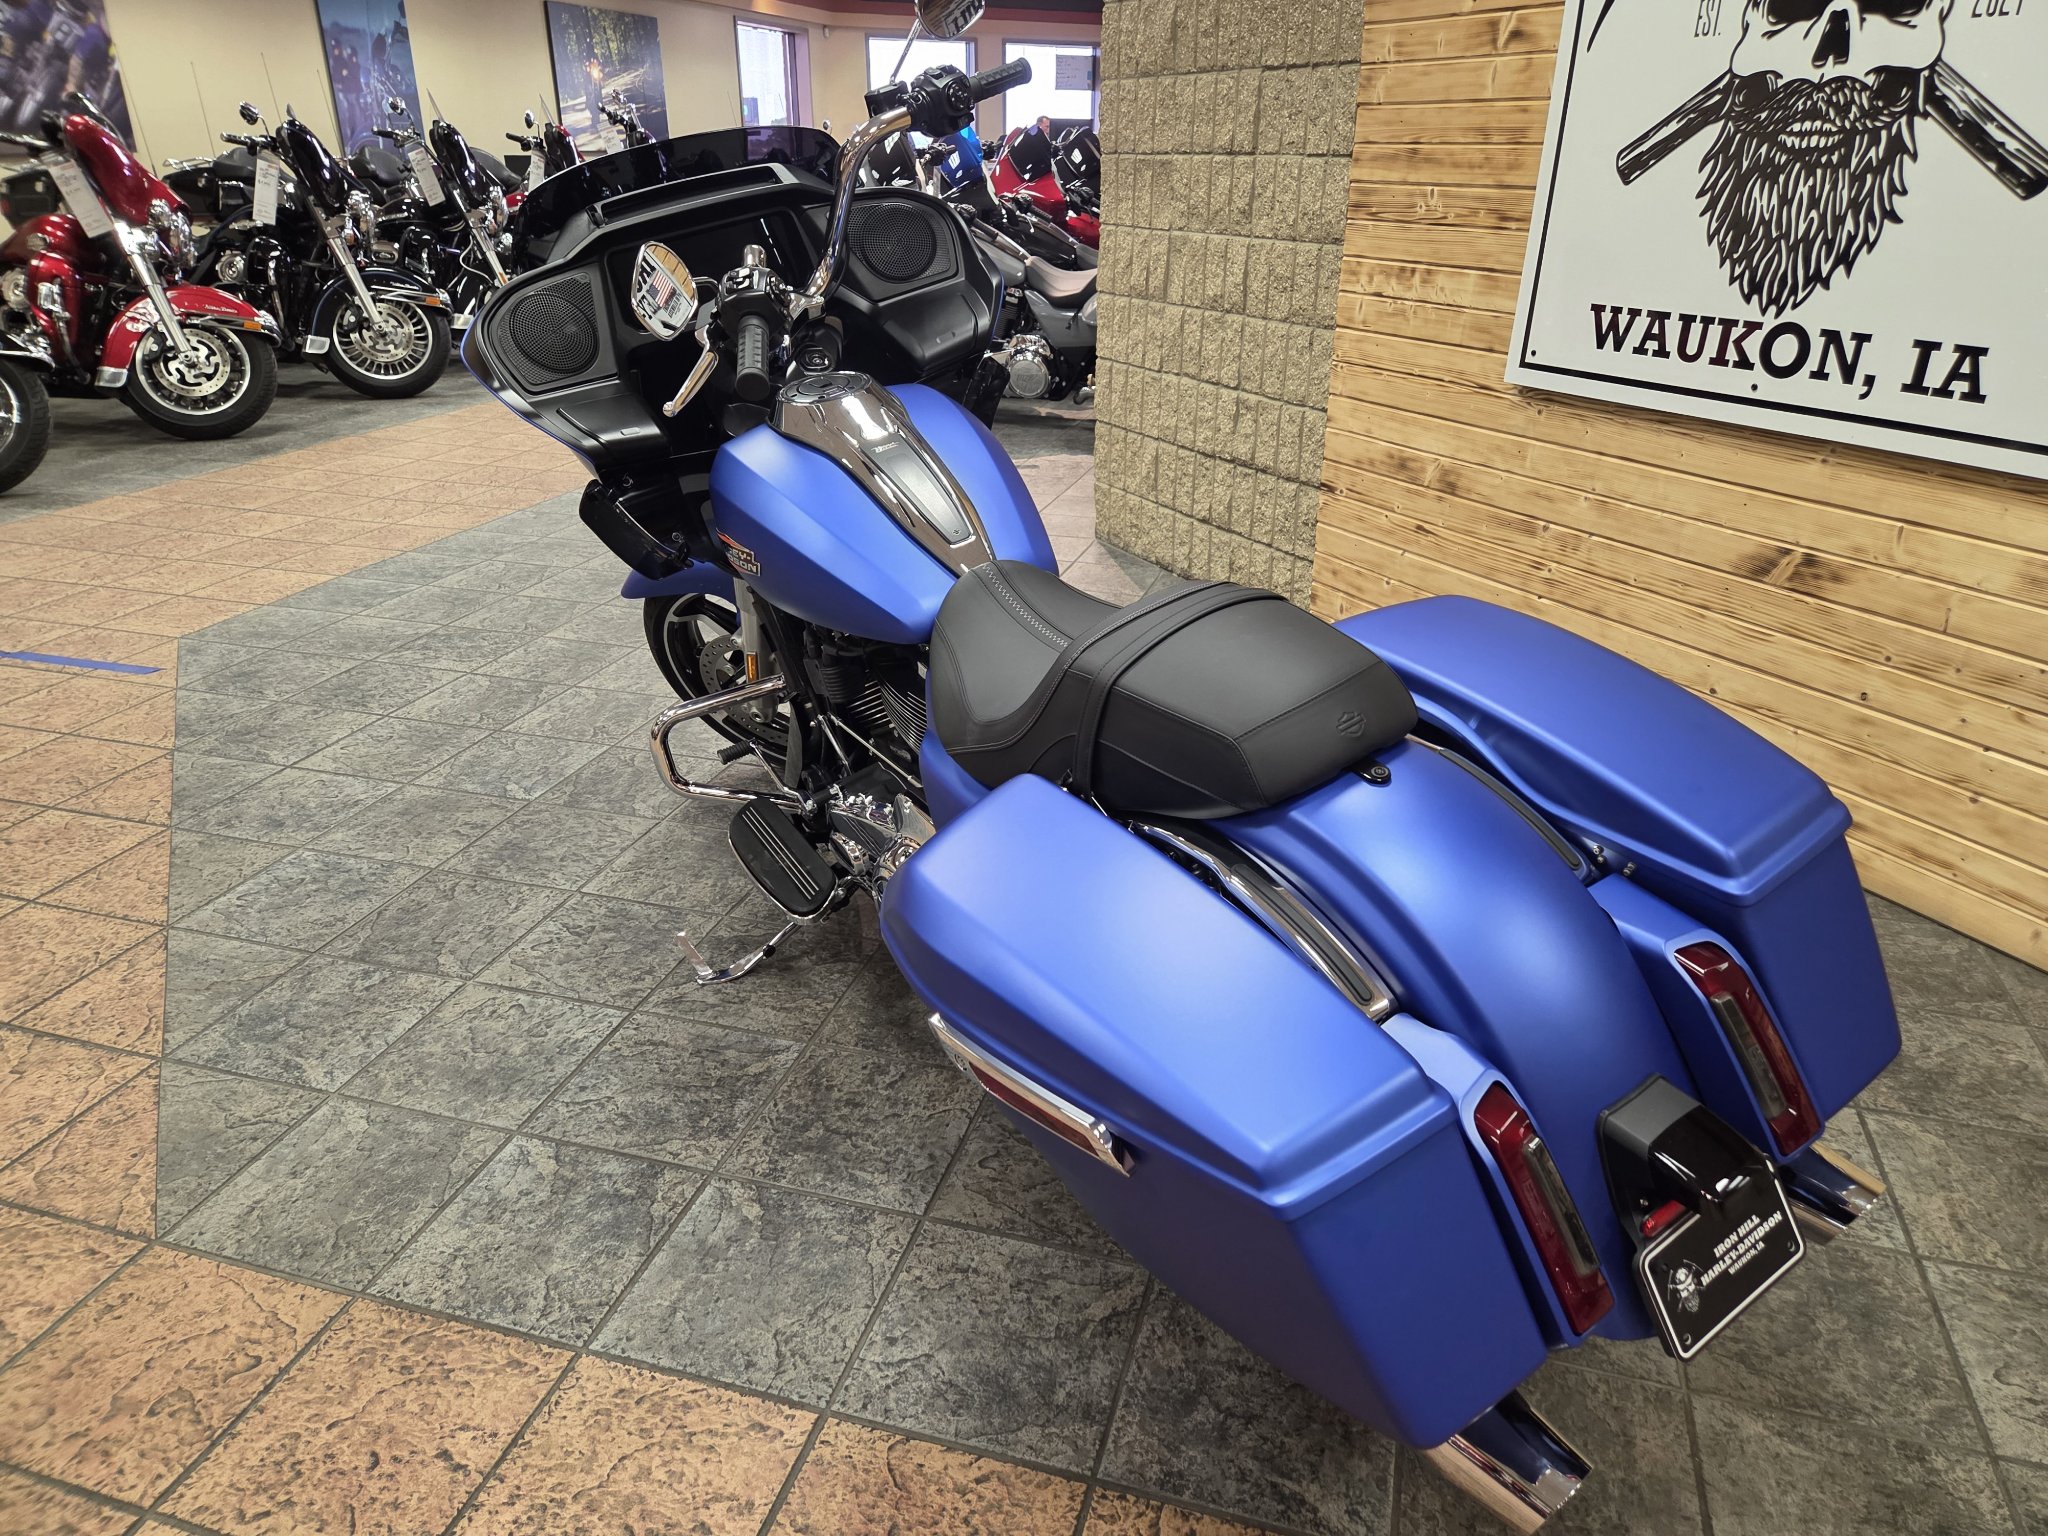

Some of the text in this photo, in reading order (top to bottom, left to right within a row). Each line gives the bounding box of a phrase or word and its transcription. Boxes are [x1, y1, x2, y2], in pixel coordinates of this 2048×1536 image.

[1590, 303, 1990, 404] WAUKON, IA
[1700, 1210, 1783, 1287] HARLEY-DAVIDSON
[1713, 1214, 1761, 1258] IRON HILL
